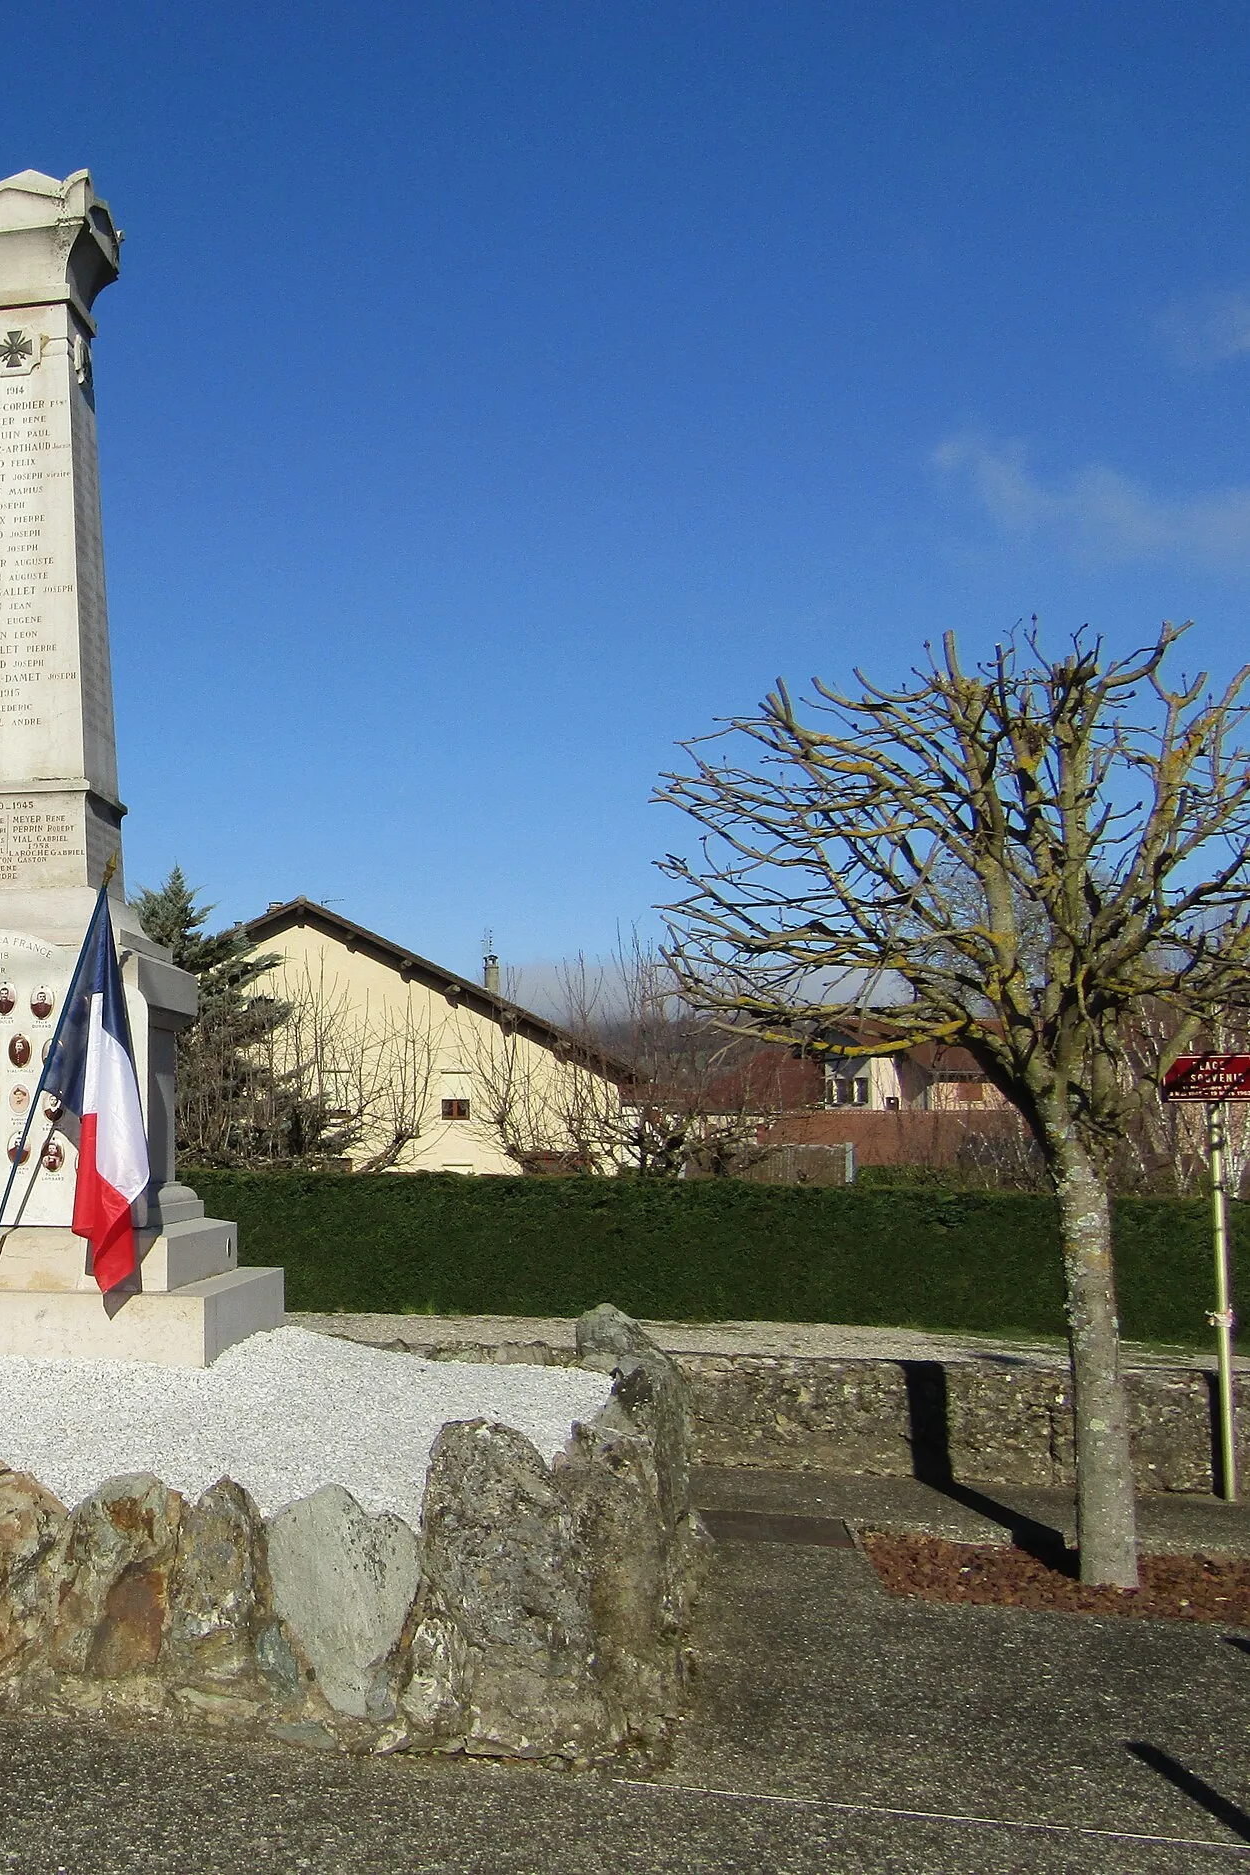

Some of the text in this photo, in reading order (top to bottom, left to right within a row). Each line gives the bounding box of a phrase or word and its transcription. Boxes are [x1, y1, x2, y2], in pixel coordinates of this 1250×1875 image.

[7, 386, 24, 395] 1914
[11, 459, 36, 467] FELIX
[13, 472, 43, 480] JOSEPH
[9, 486, 43, 495] MARIUS
[14, 515, 45, 523] PIERRE
[7, 544, 38, 552] JOSEPH
[14, 557, 54, 566] AUGUSTE
[9, 572, 48, 581] AUGUSTE
[9, 602, 31, 610] JEAN
[8, 616, 42, 624] EUGENE
[14, 631, 38, 639] LEON
[27, 644, 57, 652] PIERRE
[13, 660, 44, 668] JOSEPH
[48, 672, 76, 680] JOSEPH
[0, 689, 20, 697] 1915
[12, 718, 41, 726] ANDRE
[13, 815, 41, 823] MEYER
[14, 938, 51, 958] FRANCE
